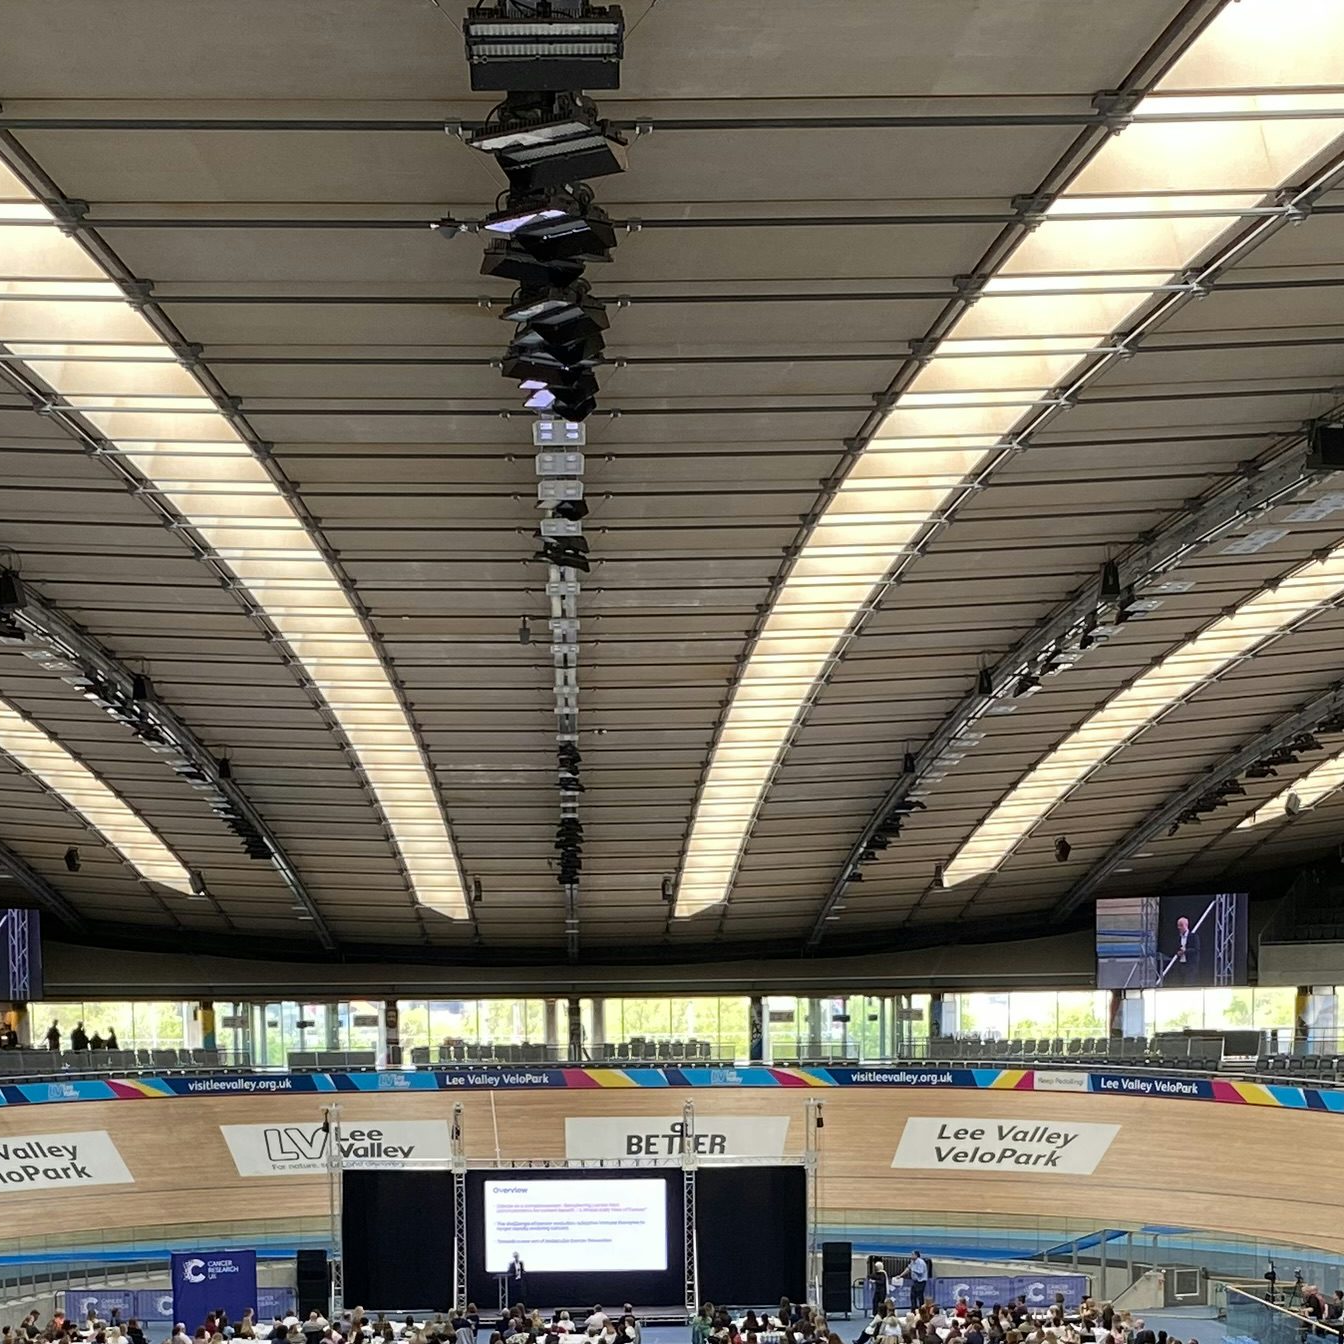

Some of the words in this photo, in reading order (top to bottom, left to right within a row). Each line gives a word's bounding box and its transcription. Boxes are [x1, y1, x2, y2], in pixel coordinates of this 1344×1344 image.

[188, 1077, 292, 1092] visitleevalley.org.uk
[445, 1075, 465, 1086] Lee
[467, 1074, 499, 1088] Valley
[502, 1072, 549, 1085] VeloPark
[851, 1070, 953, 1085] visitleevalley.org.uk
[1101, 1077, 1120, 1089] Lee
[1122, 1079, 1152, 1094] Valley
[1154, 1080, 1198, 1094] VeloPark
[334, 1126, 384, 1142] Lee
[937, 1123, 985, 1141] Lee
[996, 1124, 1079, 1149] Valley
[336, 1142, 416, 1160] Valley
[933, 1146, 1063, 1167] VeloPark
[493, 1186, 529, 1194] Overview
[208, 1259, 233, 1267] CANCER
[208, 1266, 239, 1274] RESEARCH
